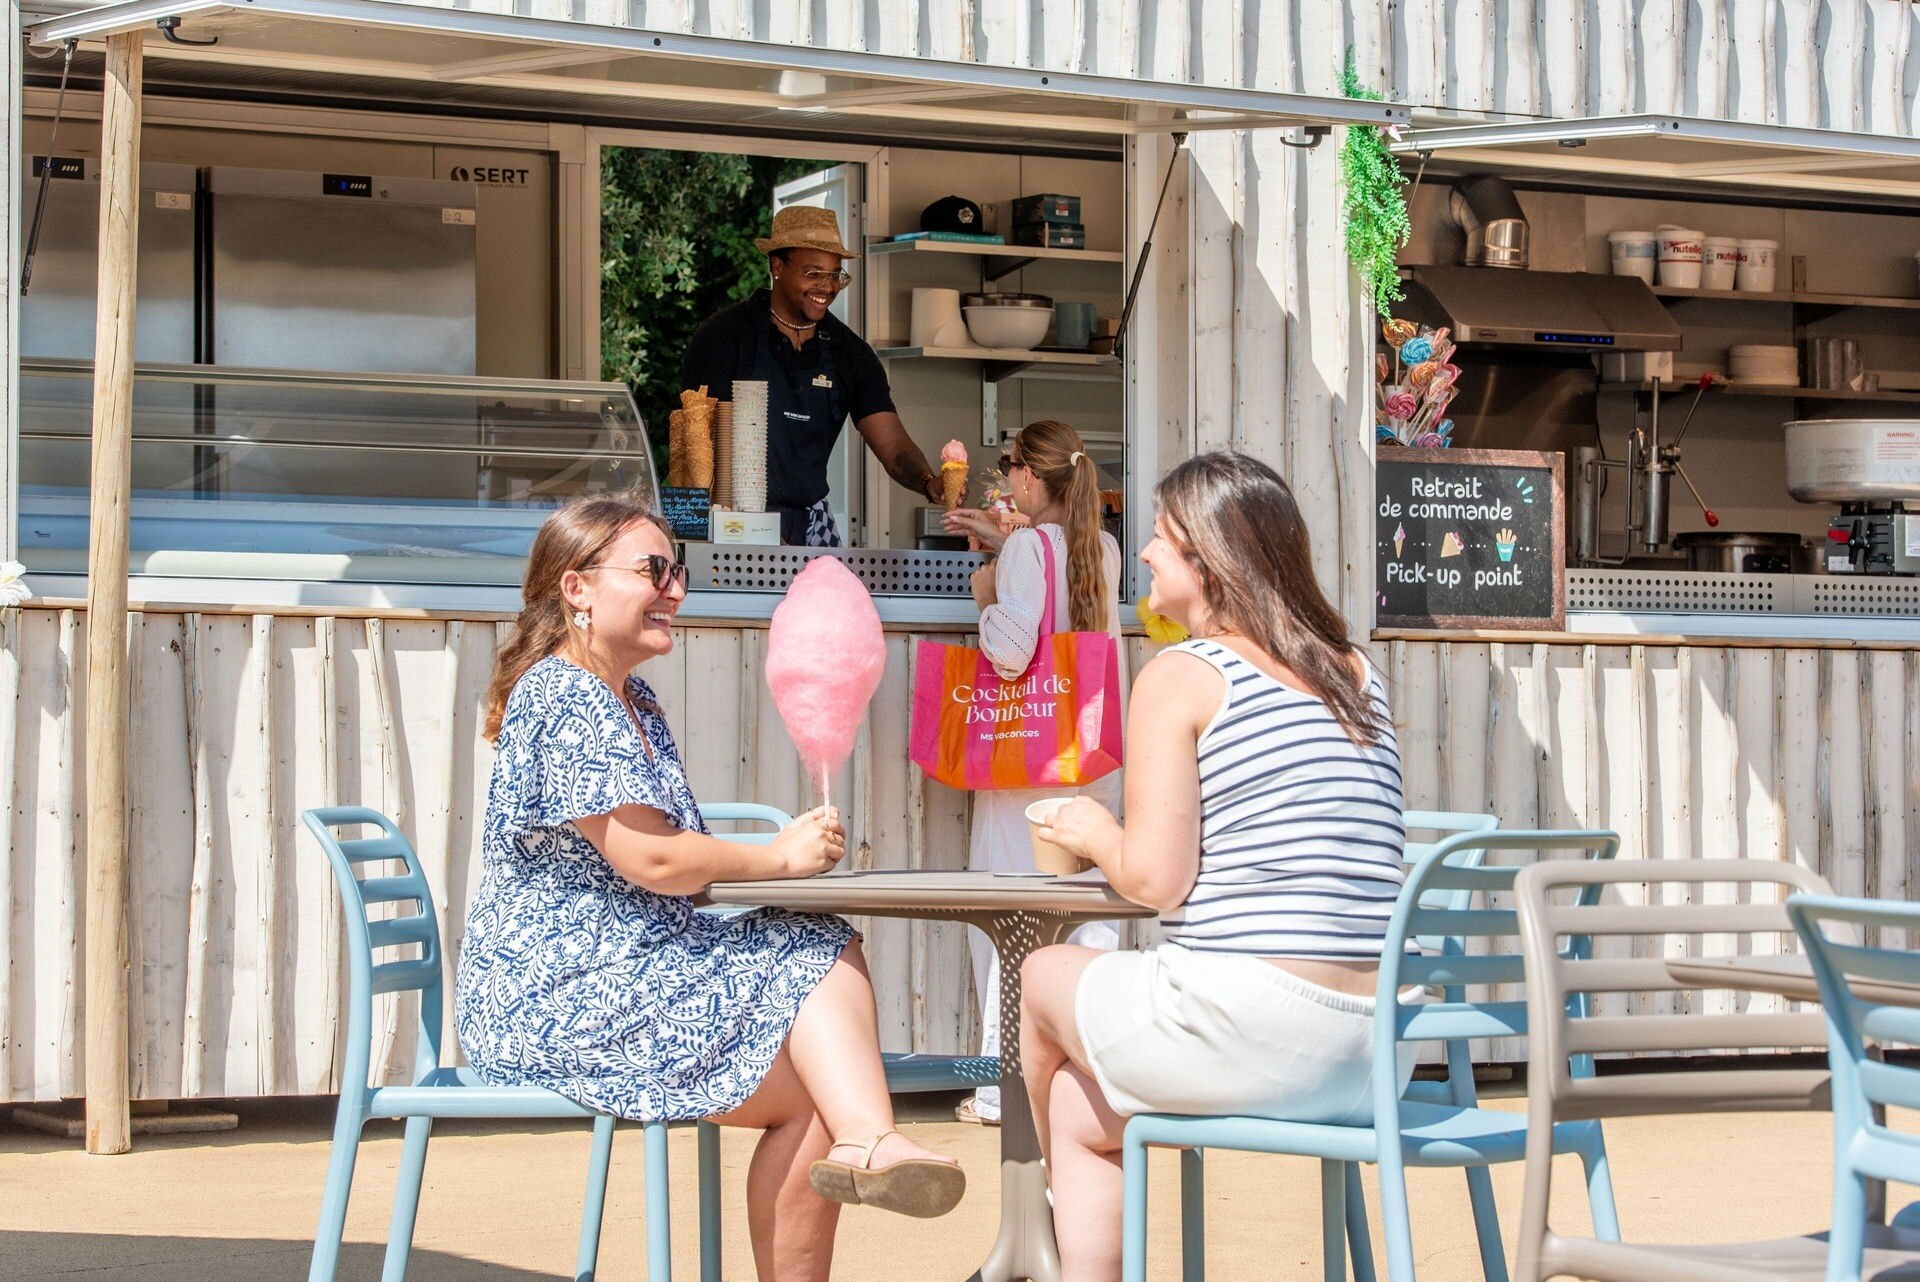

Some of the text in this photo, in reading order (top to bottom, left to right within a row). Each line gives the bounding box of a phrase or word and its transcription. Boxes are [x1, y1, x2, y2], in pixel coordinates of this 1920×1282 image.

[473, 167, 529, 183] SERT
[1411, 476, 1483, 499] Retrait
[1379, 494, 1513, 521] de commande
[1386, 562, 1523, 591] Pick-up point
[952, 673, 1072, 703] Cocktail de
[965, 702, 1057, 724] Bonheur
[980, 729, 1040, 741] Ms vacances
